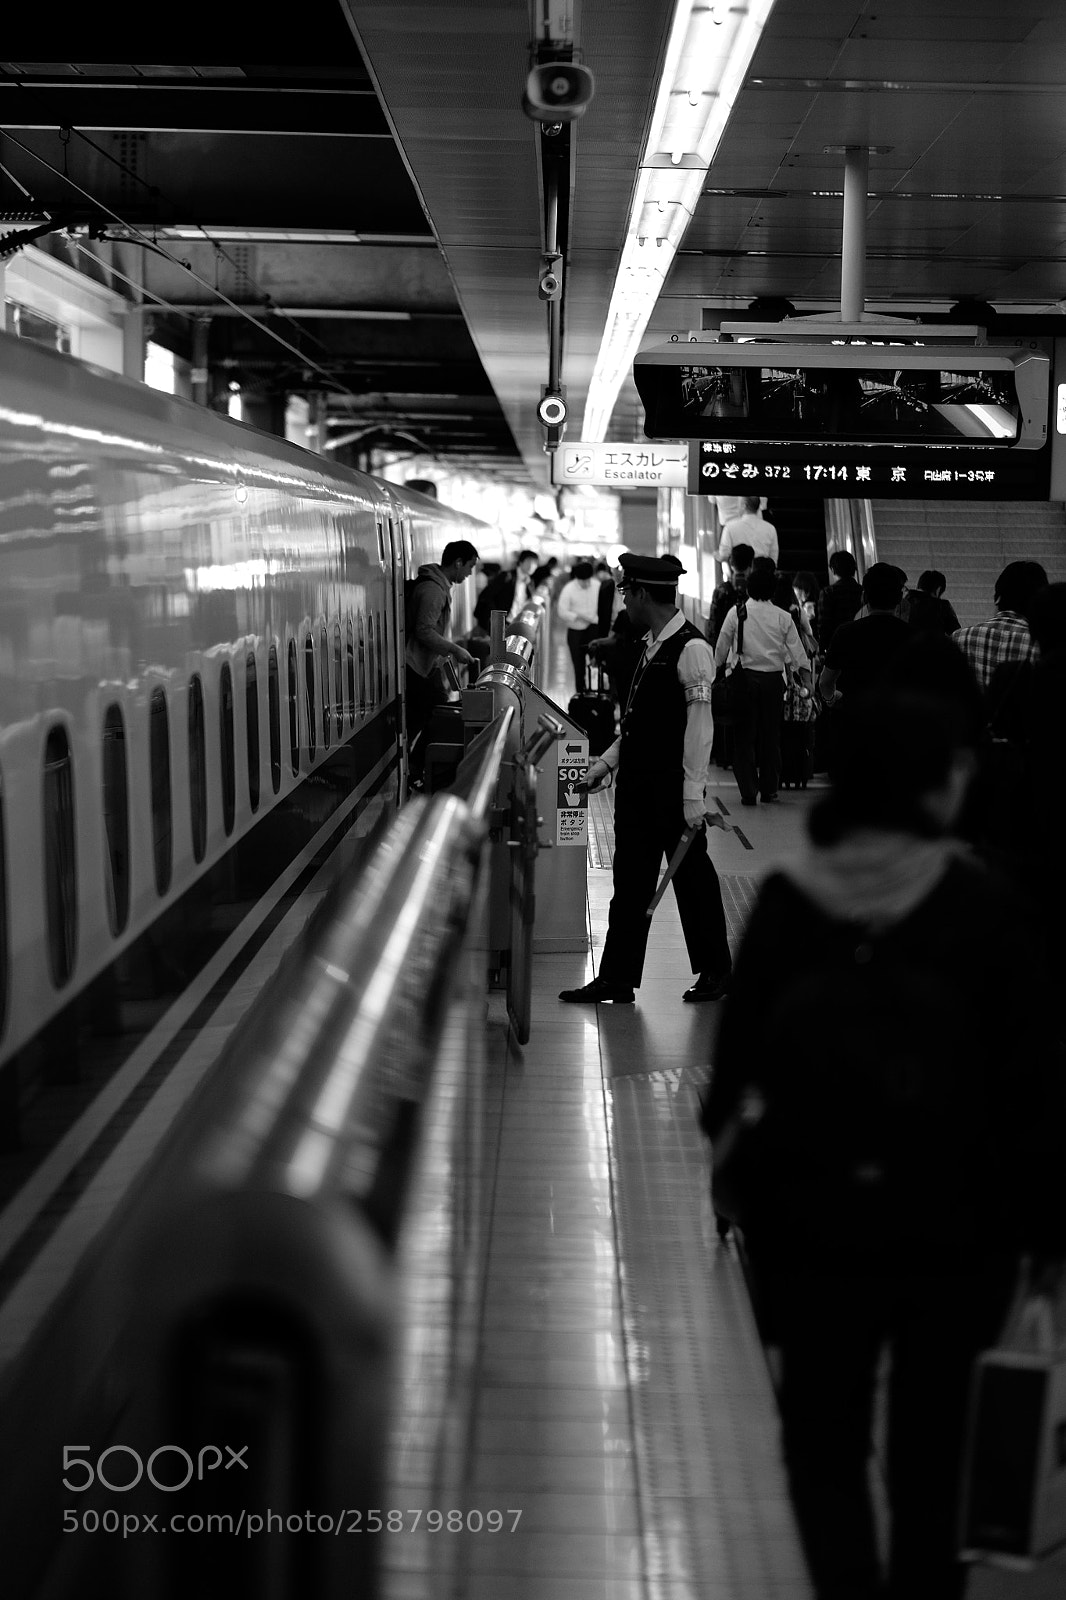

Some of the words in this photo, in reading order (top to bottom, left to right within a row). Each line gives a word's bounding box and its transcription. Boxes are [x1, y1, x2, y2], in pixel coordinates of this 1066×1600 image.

[604, 469, 662, 480] Escalator
[701, 461, 760, 479] のぞみ
[764, 465, 791, 479] 372
[803, 464, 849, 481] 17:14
[559, 768, 587, 781] SOS
[560, 810, 585, 818] 非常停止
